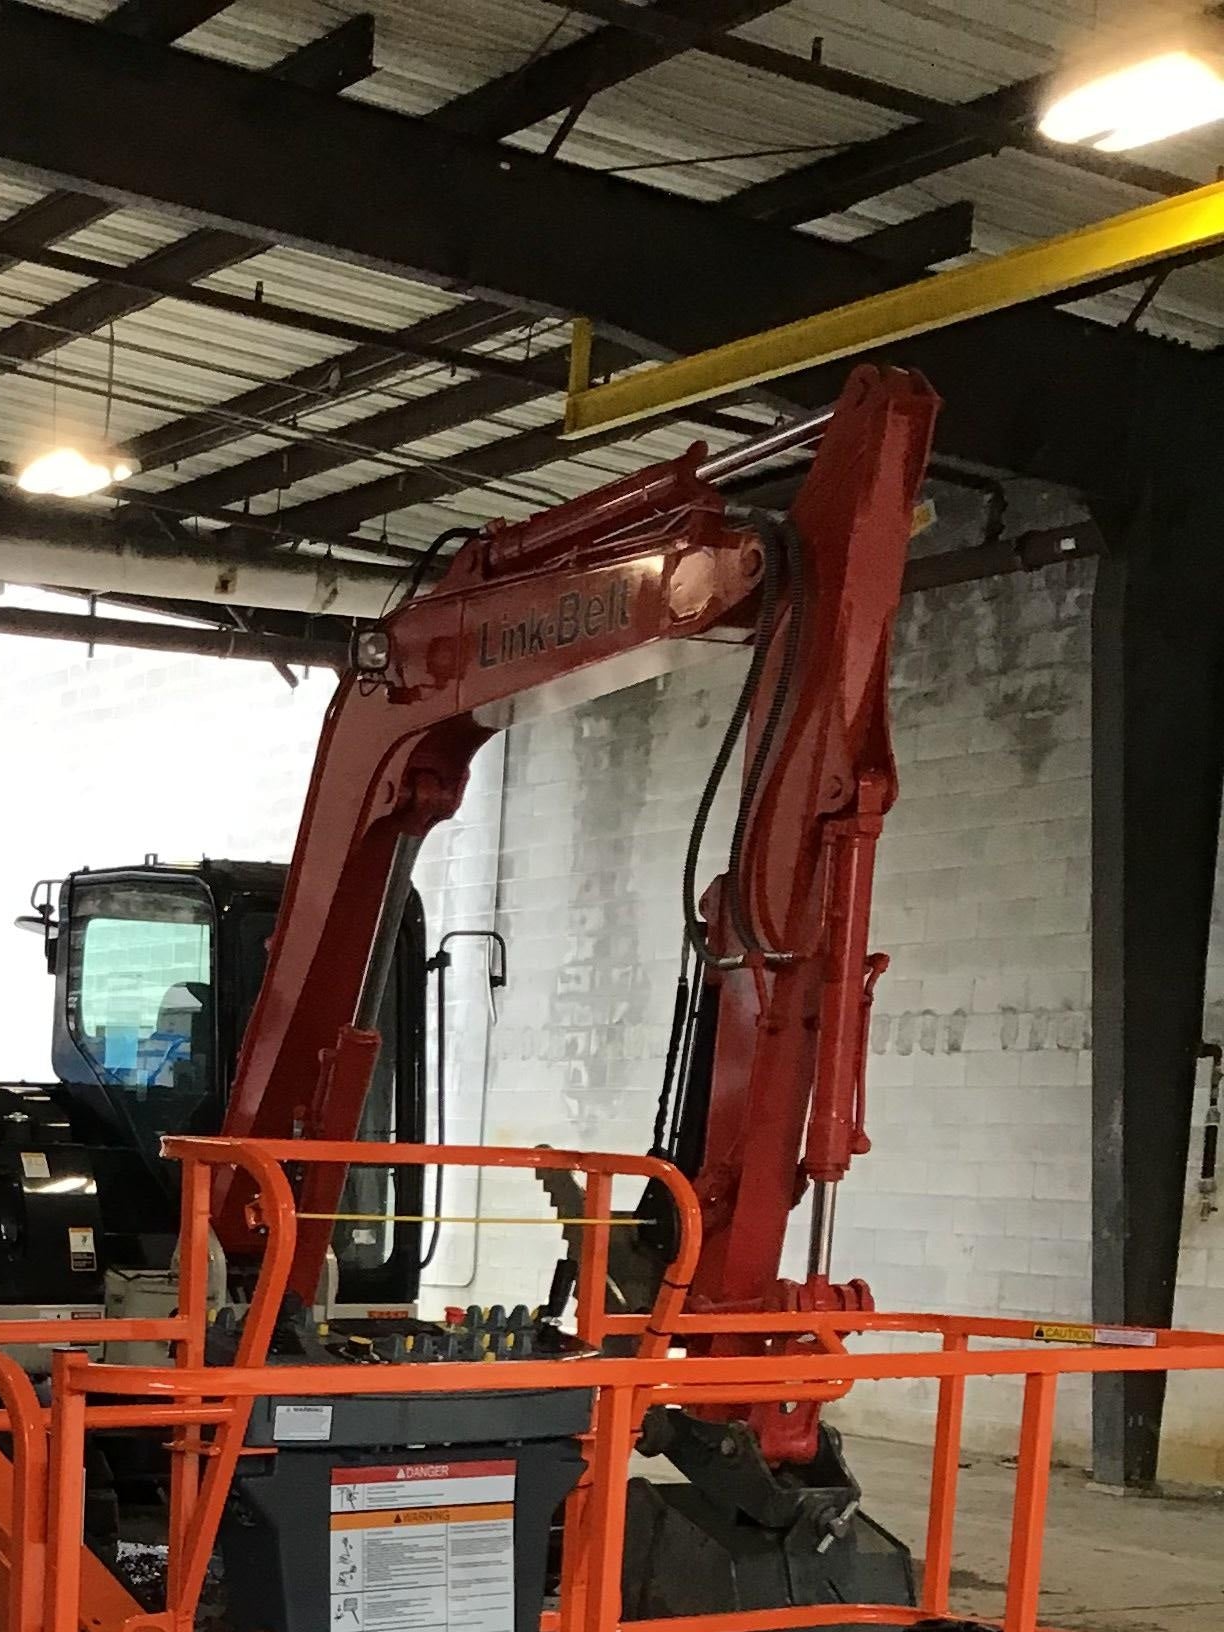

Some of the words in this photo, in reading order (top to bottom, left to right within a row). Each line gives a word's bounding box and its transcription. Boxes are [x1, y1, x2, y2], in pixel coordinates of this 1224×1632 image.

[1045, 1326, 1093, 1341] CAUTION
[404, 1464, 450, 1479] DANGER
[402, 1509, 451, 1524] WARNING
